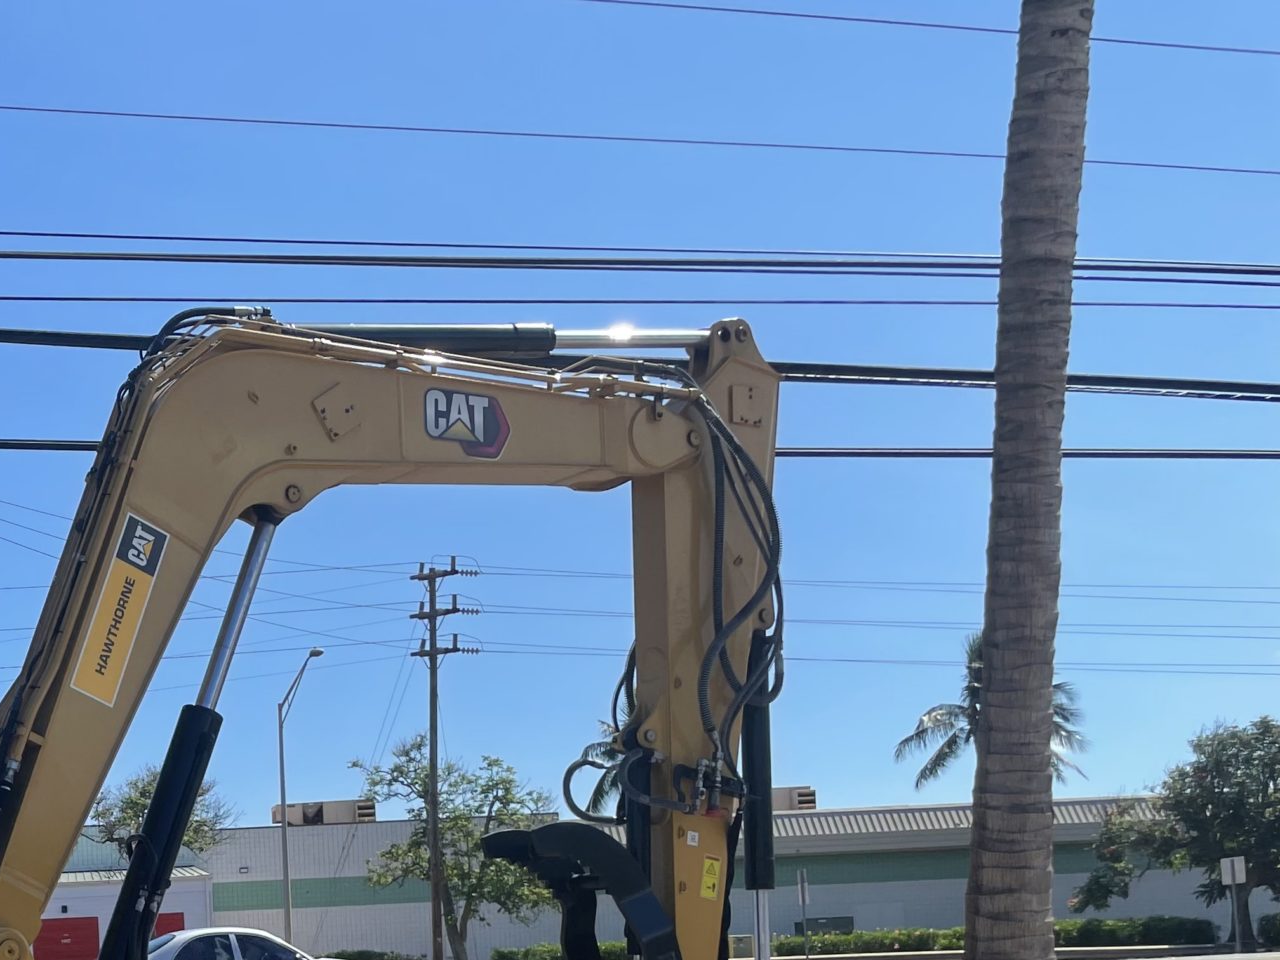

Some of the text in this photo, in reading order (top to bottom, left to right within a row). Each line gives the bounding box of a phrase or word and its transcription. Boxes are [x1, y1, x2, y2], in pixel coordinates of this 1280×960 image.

[426, 390, 488, 442] CAT
[128, 523, 156, 567] CAT
[95, 576, 136, 675] HAWTHORNE
